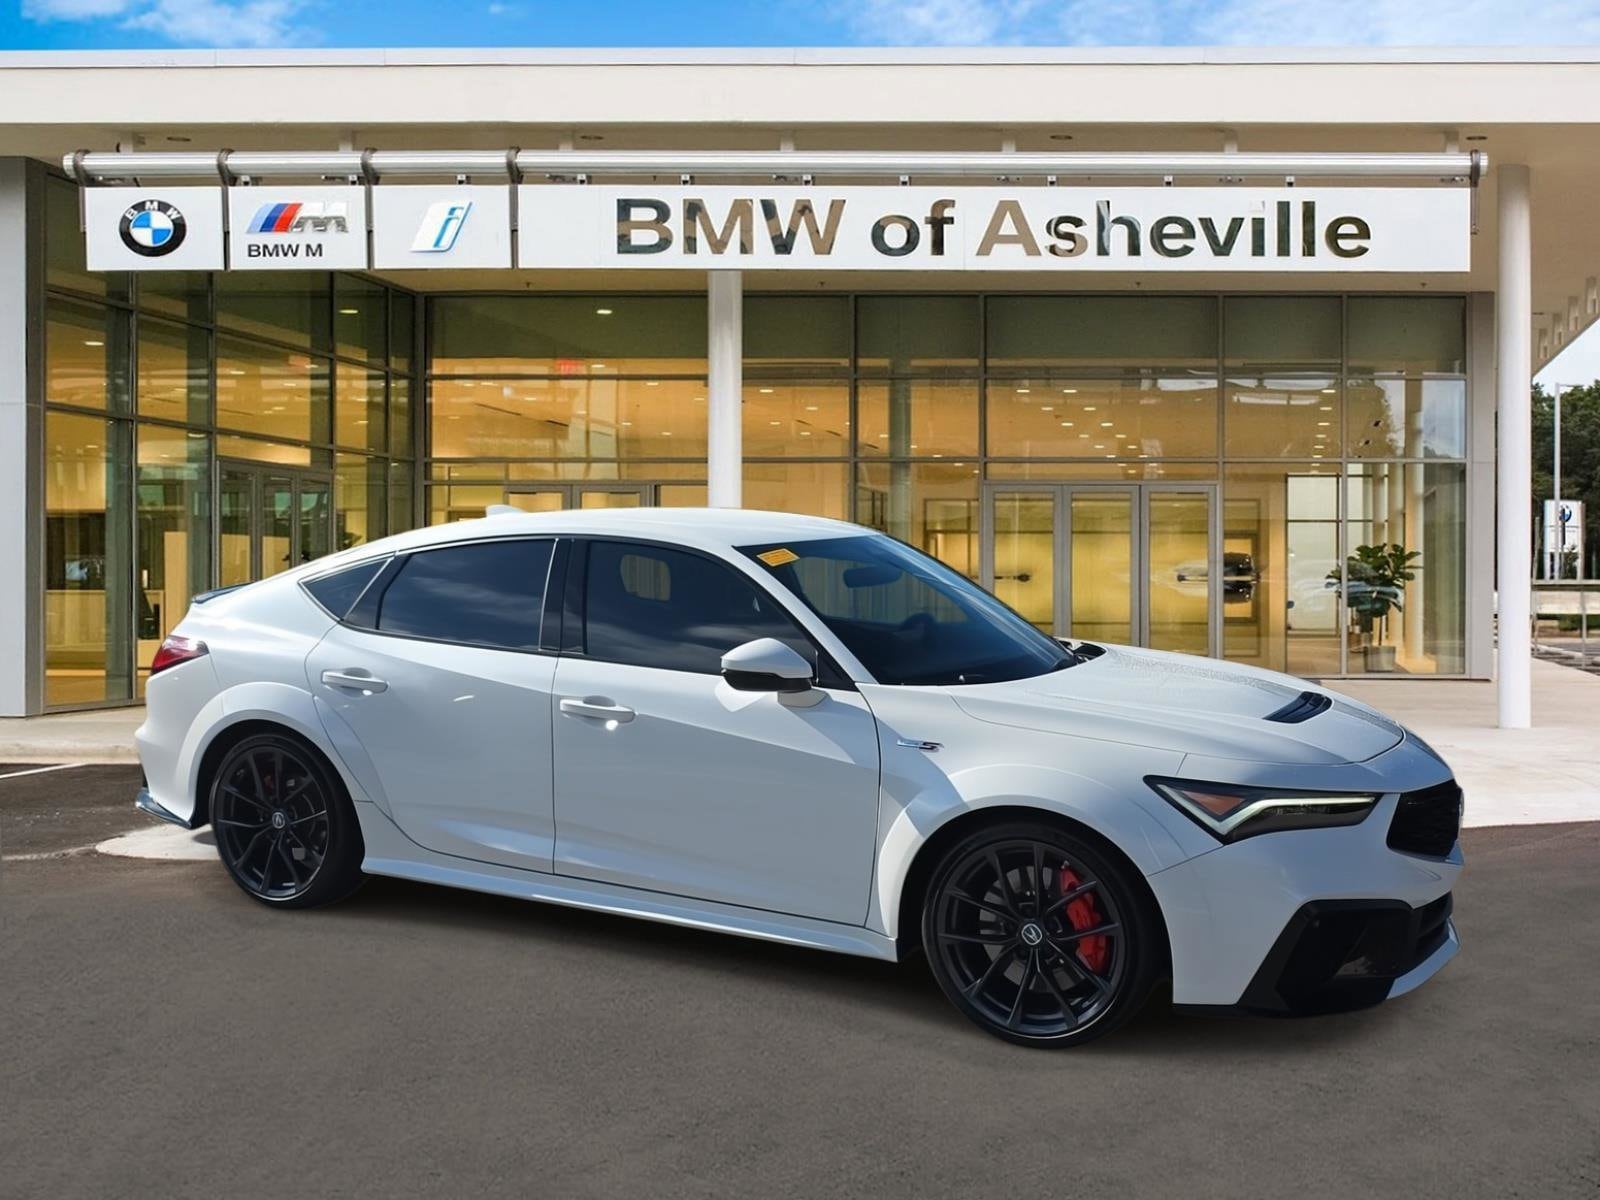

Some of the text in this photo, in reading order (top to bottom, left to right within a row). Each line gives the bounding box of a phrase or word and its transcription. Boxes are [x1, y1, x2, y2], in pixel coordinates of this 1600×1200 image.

[124, 200, 182, 220] BMW
[616, 198, 1372, 258] BMW of Asheville
[247, 243, 323, 257] BMW M
